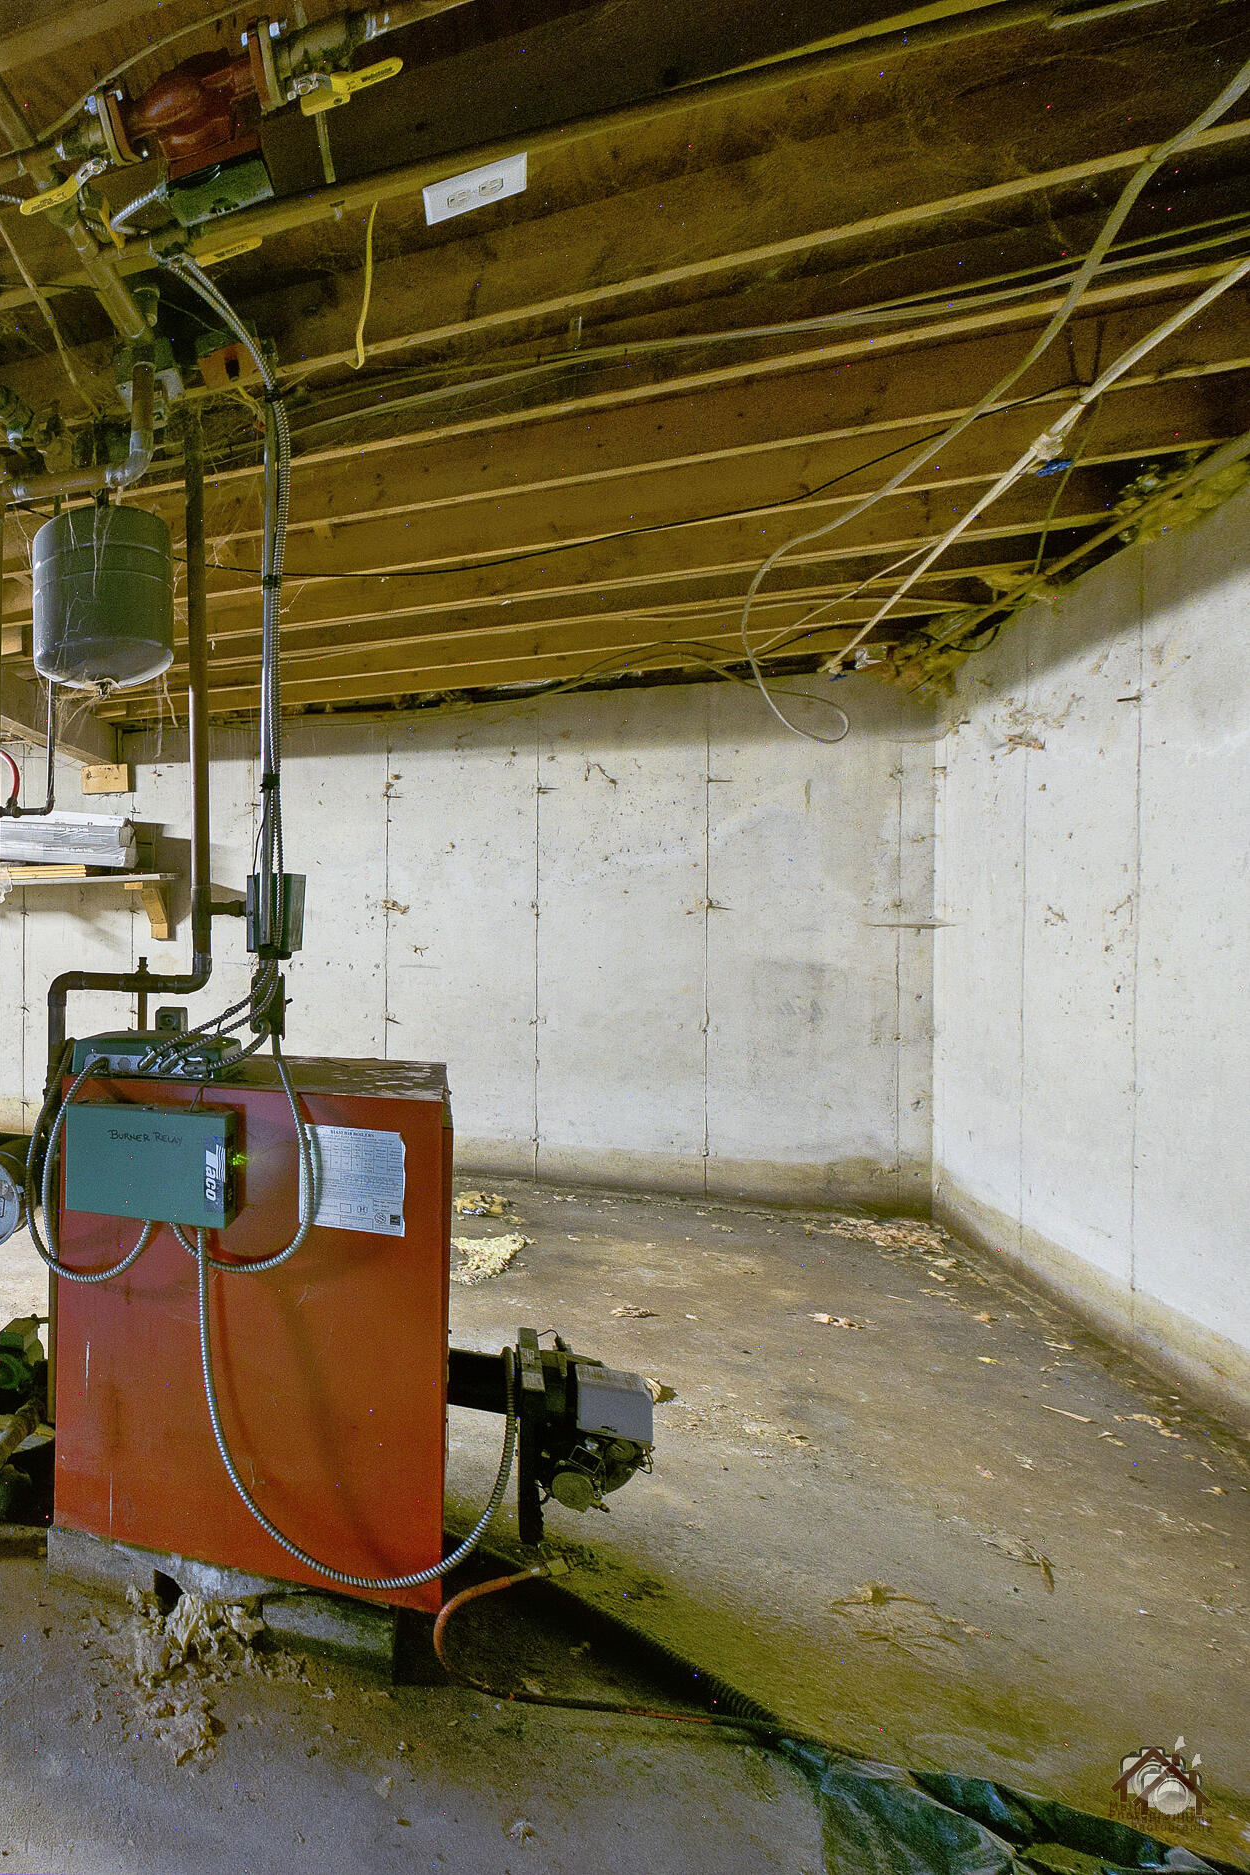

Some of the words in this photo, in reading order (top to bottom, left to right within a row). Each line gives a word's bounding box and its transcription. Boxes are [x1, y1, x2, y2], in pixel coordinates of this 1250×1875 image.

[107, 1129, 150, 1143] BURNER
[153, 1131, 183, 1146] RELAY
[205, 1143, 226, 1202] Taco
